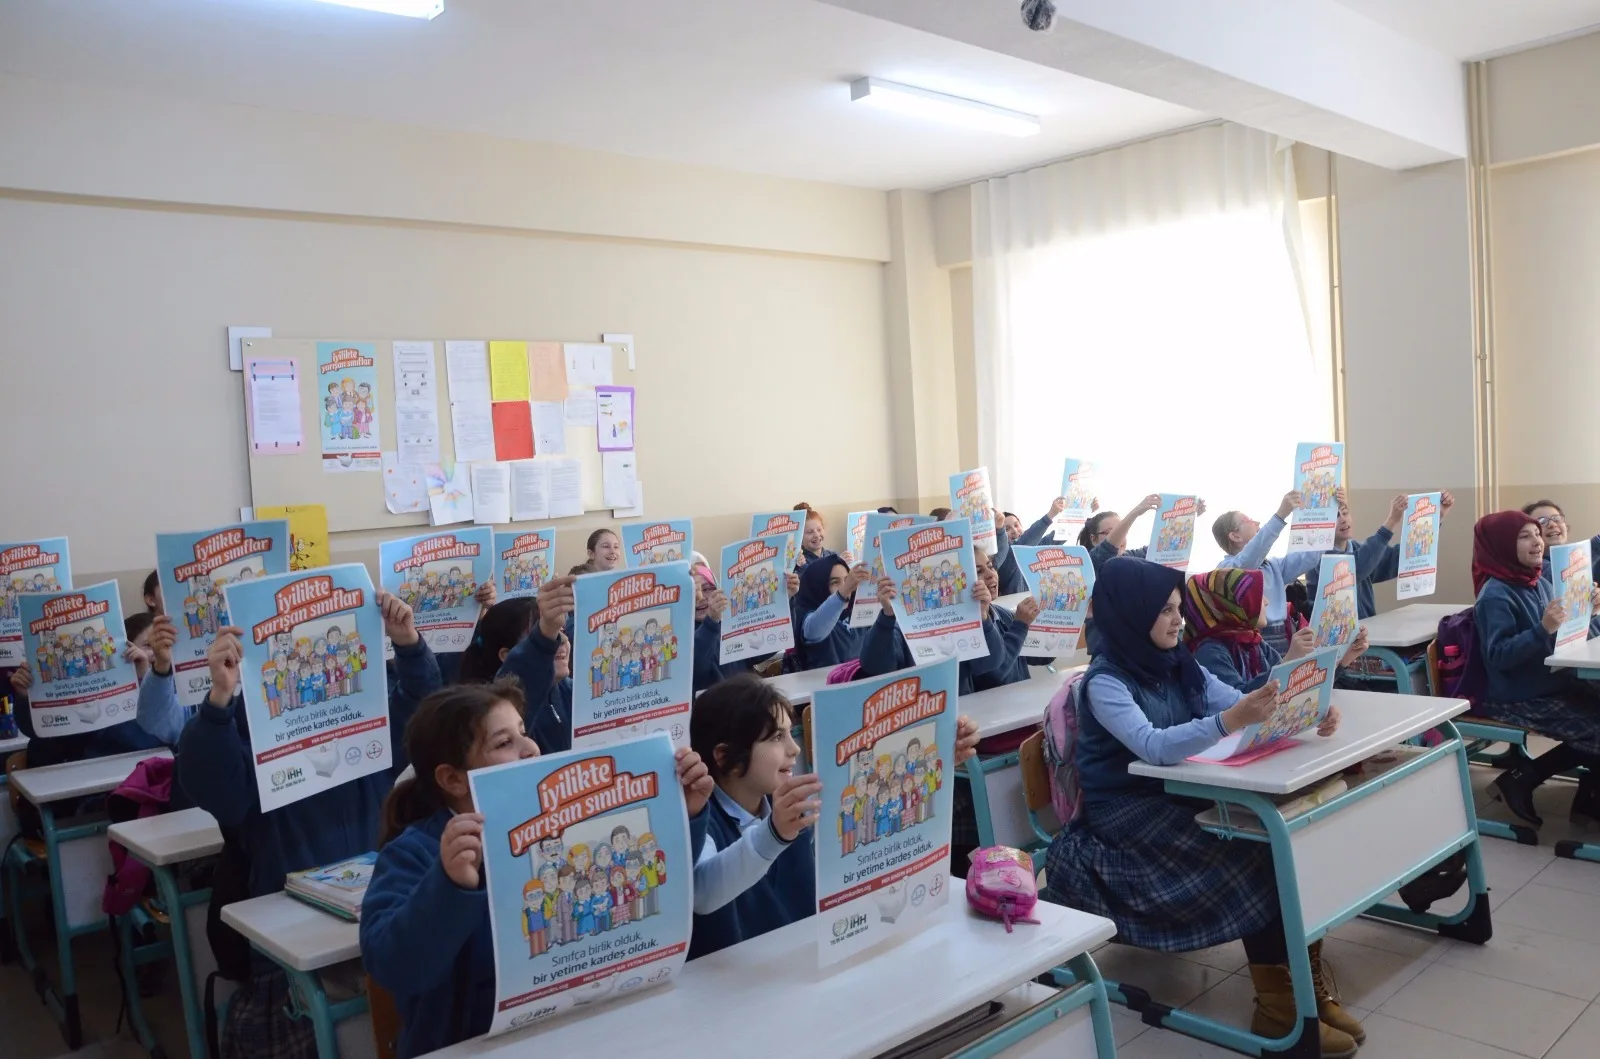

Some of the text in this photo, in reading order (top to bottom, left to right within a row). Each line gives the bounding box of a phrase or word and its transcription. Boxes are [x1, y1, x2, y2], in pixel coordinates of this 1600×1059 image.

[176, 539, 268, 582] yarışan sınıflar
[196, 531, 241, 560] iyilikte
[395, 543, 477, 571] yarışan sınıflar
[414, 536, 453, 556] iyilikte
[278, 579, 330, 613] iyilikte
[610, 575, 652, 605] iyilikte
[31, 602, 106, 633] yarışan sınıflar
[44, 597, 83, 617] iyilikte
[255, 589, 359, 642] yarışan sınıflar
[590, 586, 677, 632] yarışan sınıflar
[285, 715, 309, 728] Sınıfça
[310, 709, 327, 719] birlik
[865, 683, 917, 726] iyilikte
[275, 732, 285, 742] bir
[286, 723, 312, 740] yetime
[314, 717, 339, 731] kardeş
[840, 694, 942, 764] yarışan sınıflar
[542, 762, 611, 811] iyilikte
[513, 776, 651, 853] yarışan sınıflar
[843, 873, 854, 884] bir
[856, 863, 885, 882] yetime
[886, 852, 912, 868] kardeş
[857, 850, 883, 866] Sınıfça
[884, 843, 902, 856] birlik
[533, 972, 547, 985] bir
[550, 961, 588, 982] yetime
[590, 951, 626, 968] kardeş
[552, 947, 585, 967] Sınıfça
[588, 939, 612, 954] birlik
